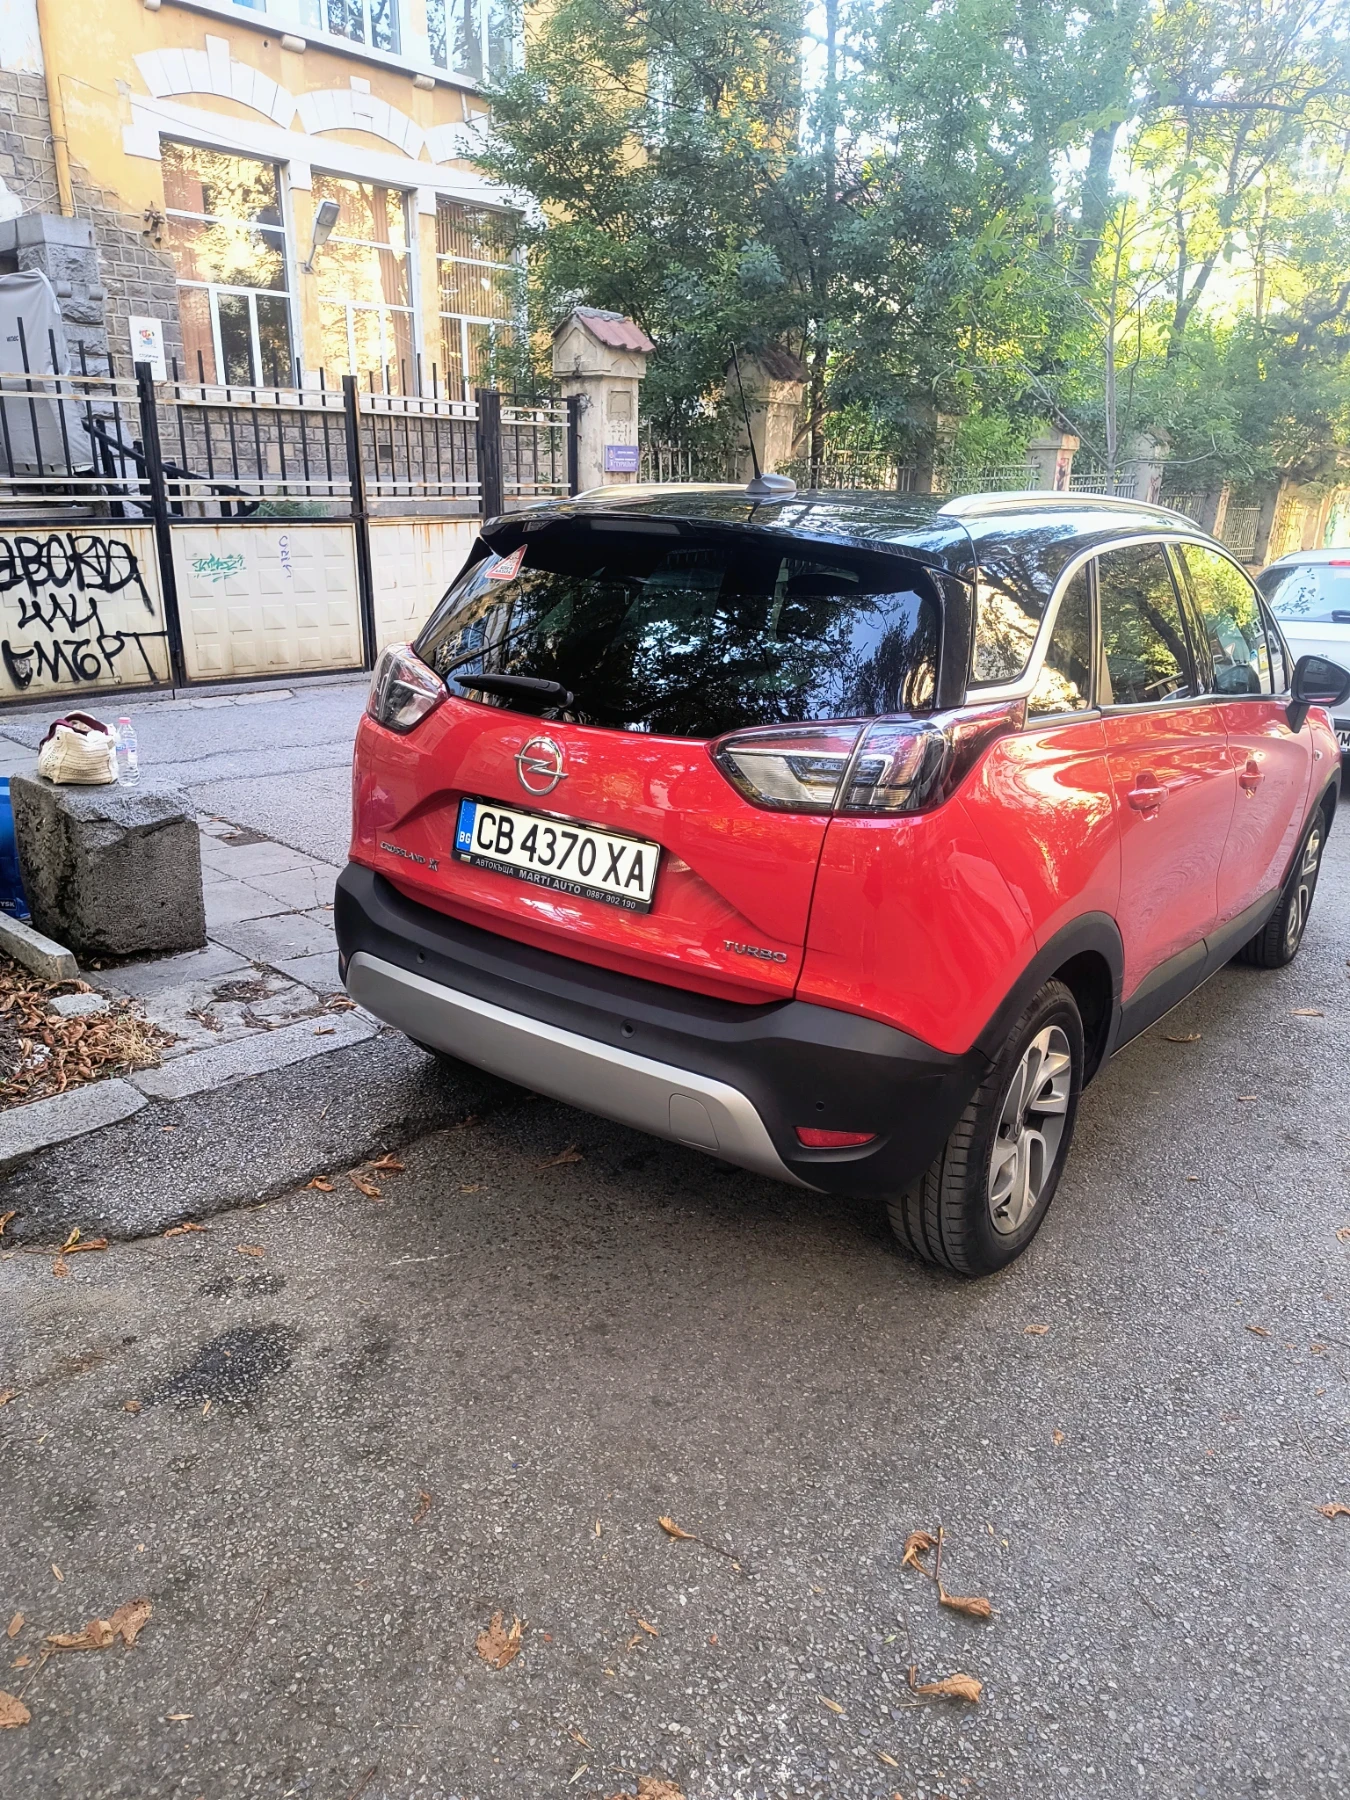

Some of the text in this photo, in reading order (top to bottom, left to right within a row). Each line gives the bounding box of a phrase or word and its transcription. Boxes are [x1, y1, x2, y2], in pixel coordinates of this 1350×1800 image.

[459, 832, 471, 844] BG
[476, 811, 644, 892] CB 4370 XA
[475, 857, 636, 909] АВТОКЪЩА MARTI AUTO 0887 902 190
[723, 939, 787, 963] TURBO
